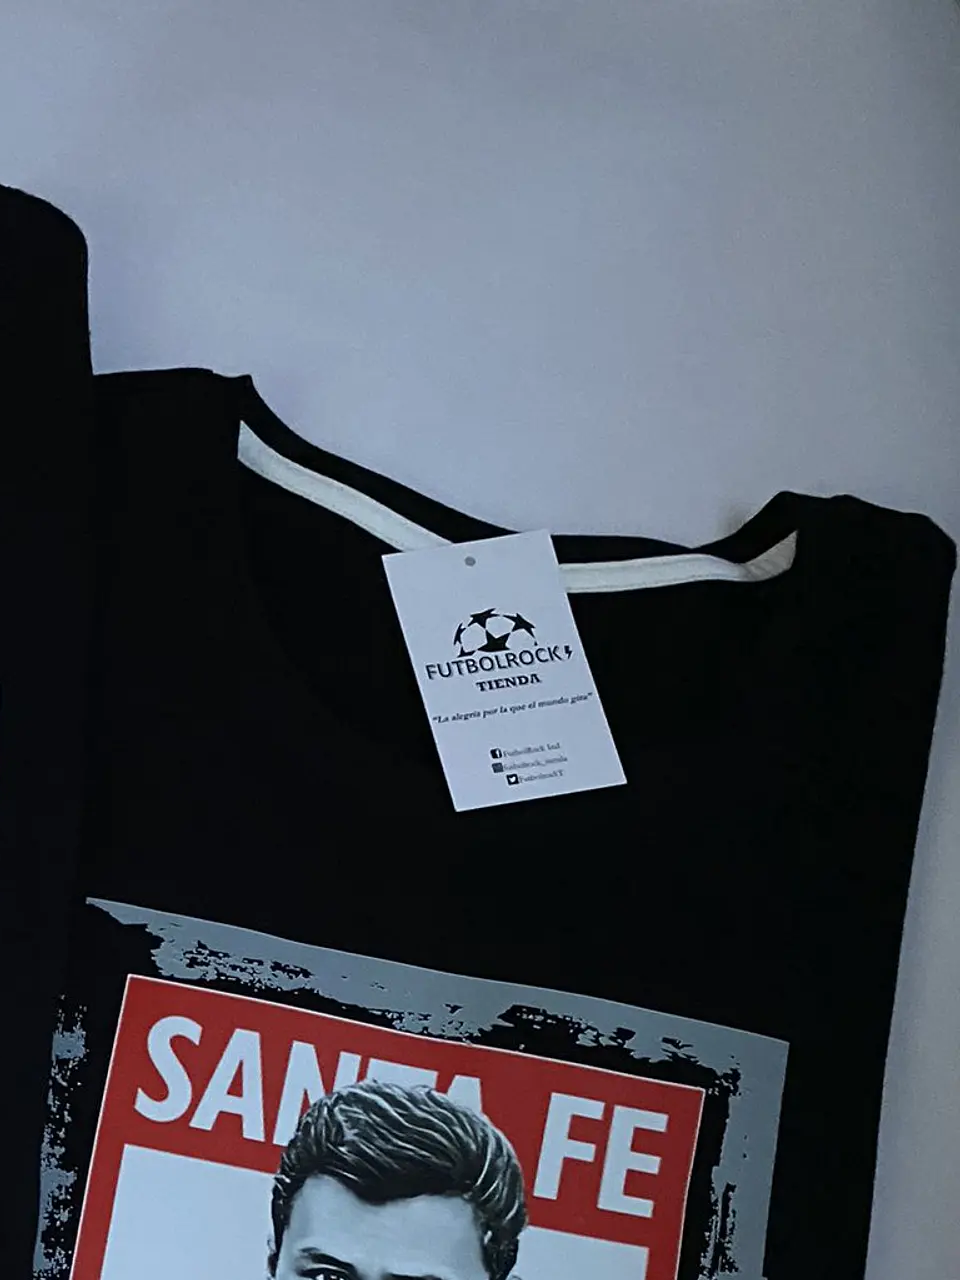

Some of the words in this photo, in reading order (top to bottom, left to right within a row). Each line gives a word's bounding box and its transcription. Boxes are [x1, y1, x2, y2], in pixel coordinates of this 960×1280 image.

[425, 645, 563, 680] FUTBOLROCK
[475, 673, 542, 692] TIENDA
[134, 1015, 484, 1147] SAN
[533, 1092, 670, 1219] FE
